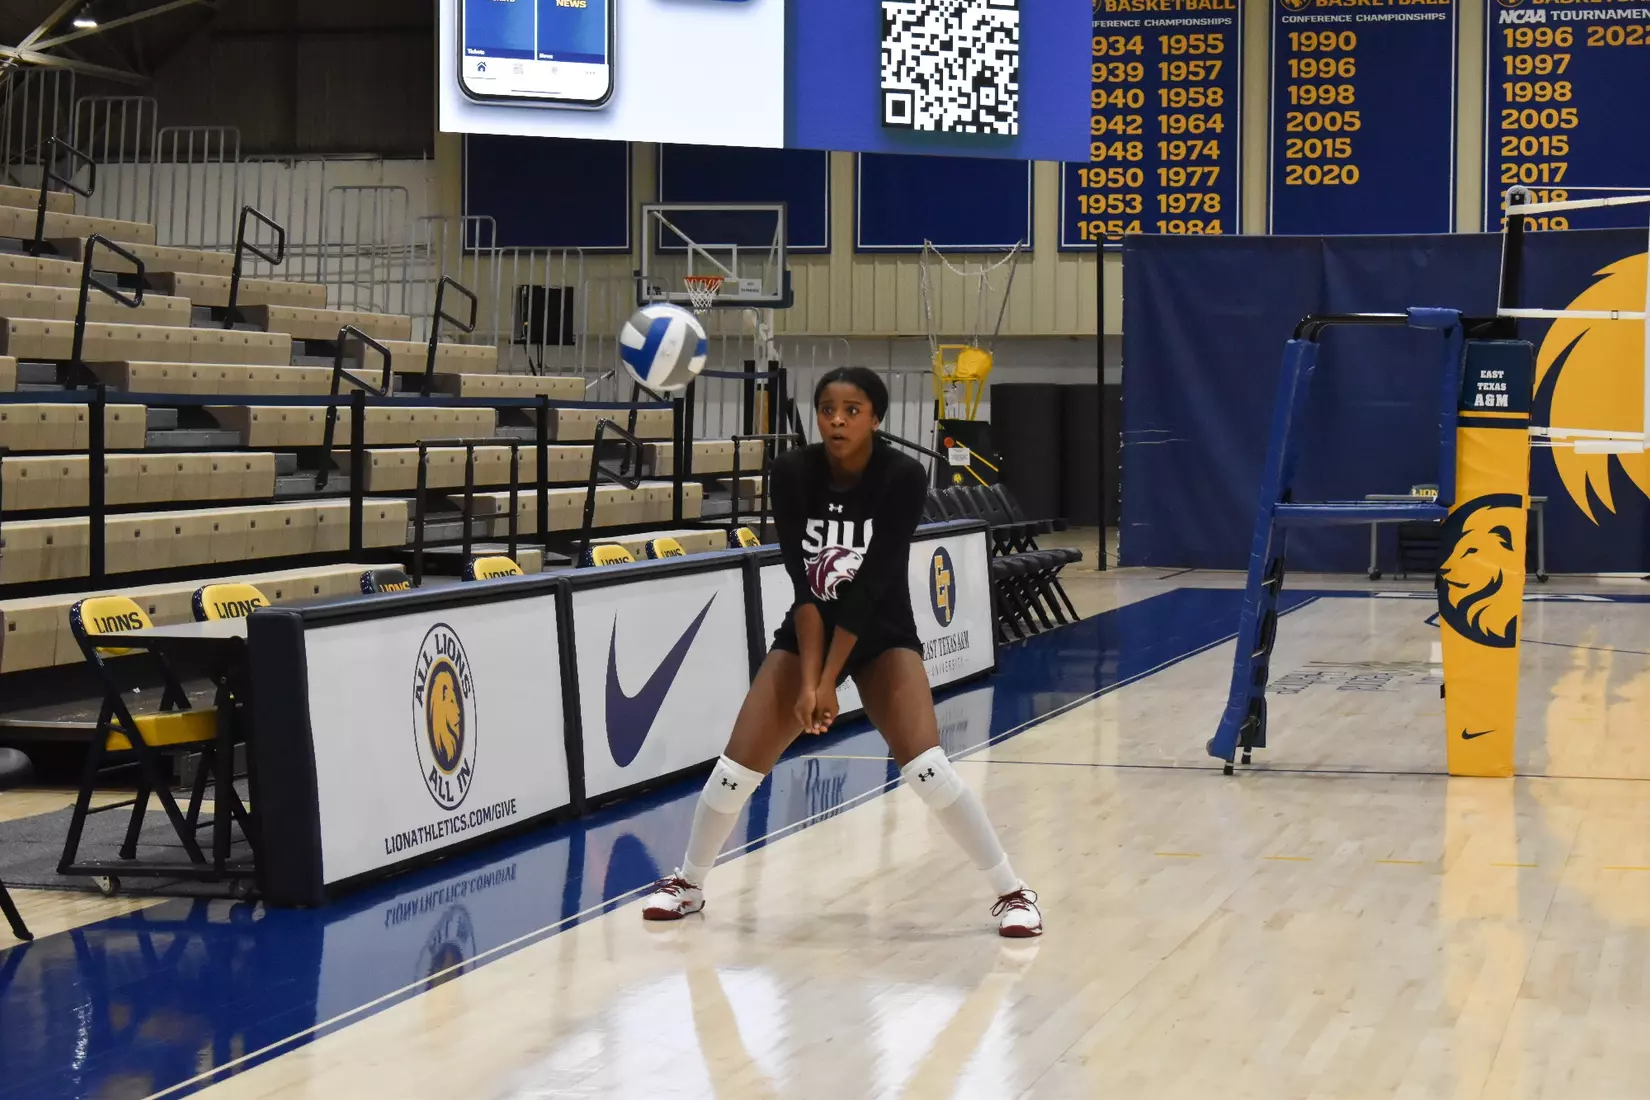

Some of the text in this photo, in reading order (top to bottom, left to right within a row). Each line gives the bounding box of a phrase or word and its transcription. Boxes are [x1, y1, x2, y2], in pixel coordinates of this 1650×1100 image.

[1105, 0, 1236, 12] BASKETBALL
[1092, 18, 1232, 28] FERENCE CHAMPIONSHIPS
[1282, 13, 1446, 23] CONFERENCE CHAMPIONSHIPS
[1499, 10, 1546, 24] NCAA
[1091, 33, 1225, 56] 934 1955
[1288, 31, 1357, 51] 1990
[1503, 25, 1650, 48] 1996 202
[1091, 60, 1223, 83] 939 1957
[1288, 57, 1356, 78] 1996
[1502, 54, 1571, 75] 1997
[1091, 87, 1224, 109] 940 1958
[1287, 84, 1355, 105] 1998
[1502, 81, 1572, 102] 1998
[1090, 113, 1225, 135] 942 1964
[1286, 111, 1361, 132] 2005
[1501, 108, 1579, 129] 2005
[1090, 140, 1220, 162] 948 1974
[1286, 138, 1352, 159] 2015
[1501, 135, 1569, 156] 2015
[1078, 166, 1220, 188] 1950 1977
[1285, 164, 1360, 185] 2020
[1500, 162, 1568, 184] 2017
[1078, 193, 1221, 214] 1953 1978
[1077, 219, 1222, 241] 1954 1984
[1480, 370, 1504, 379] EAST
[1477, 382, 1507, 391] TEXAS
[1474, 393, 1509, 407] A&M
[1412, 488, 1438, 498] LION
[801, 518, 873, 554] SIU
[214, 598, 262, 620] LIONS
[93, 611, 144, 634] LIONS
[938, 634, 957, 656] TEXAS
[415, 633, 471, 708] ALL LIONS
[428, 757, 471, 802] ALL IN
[385, 798, 517, 855] LIONATHLETICS.COM/GIVE
